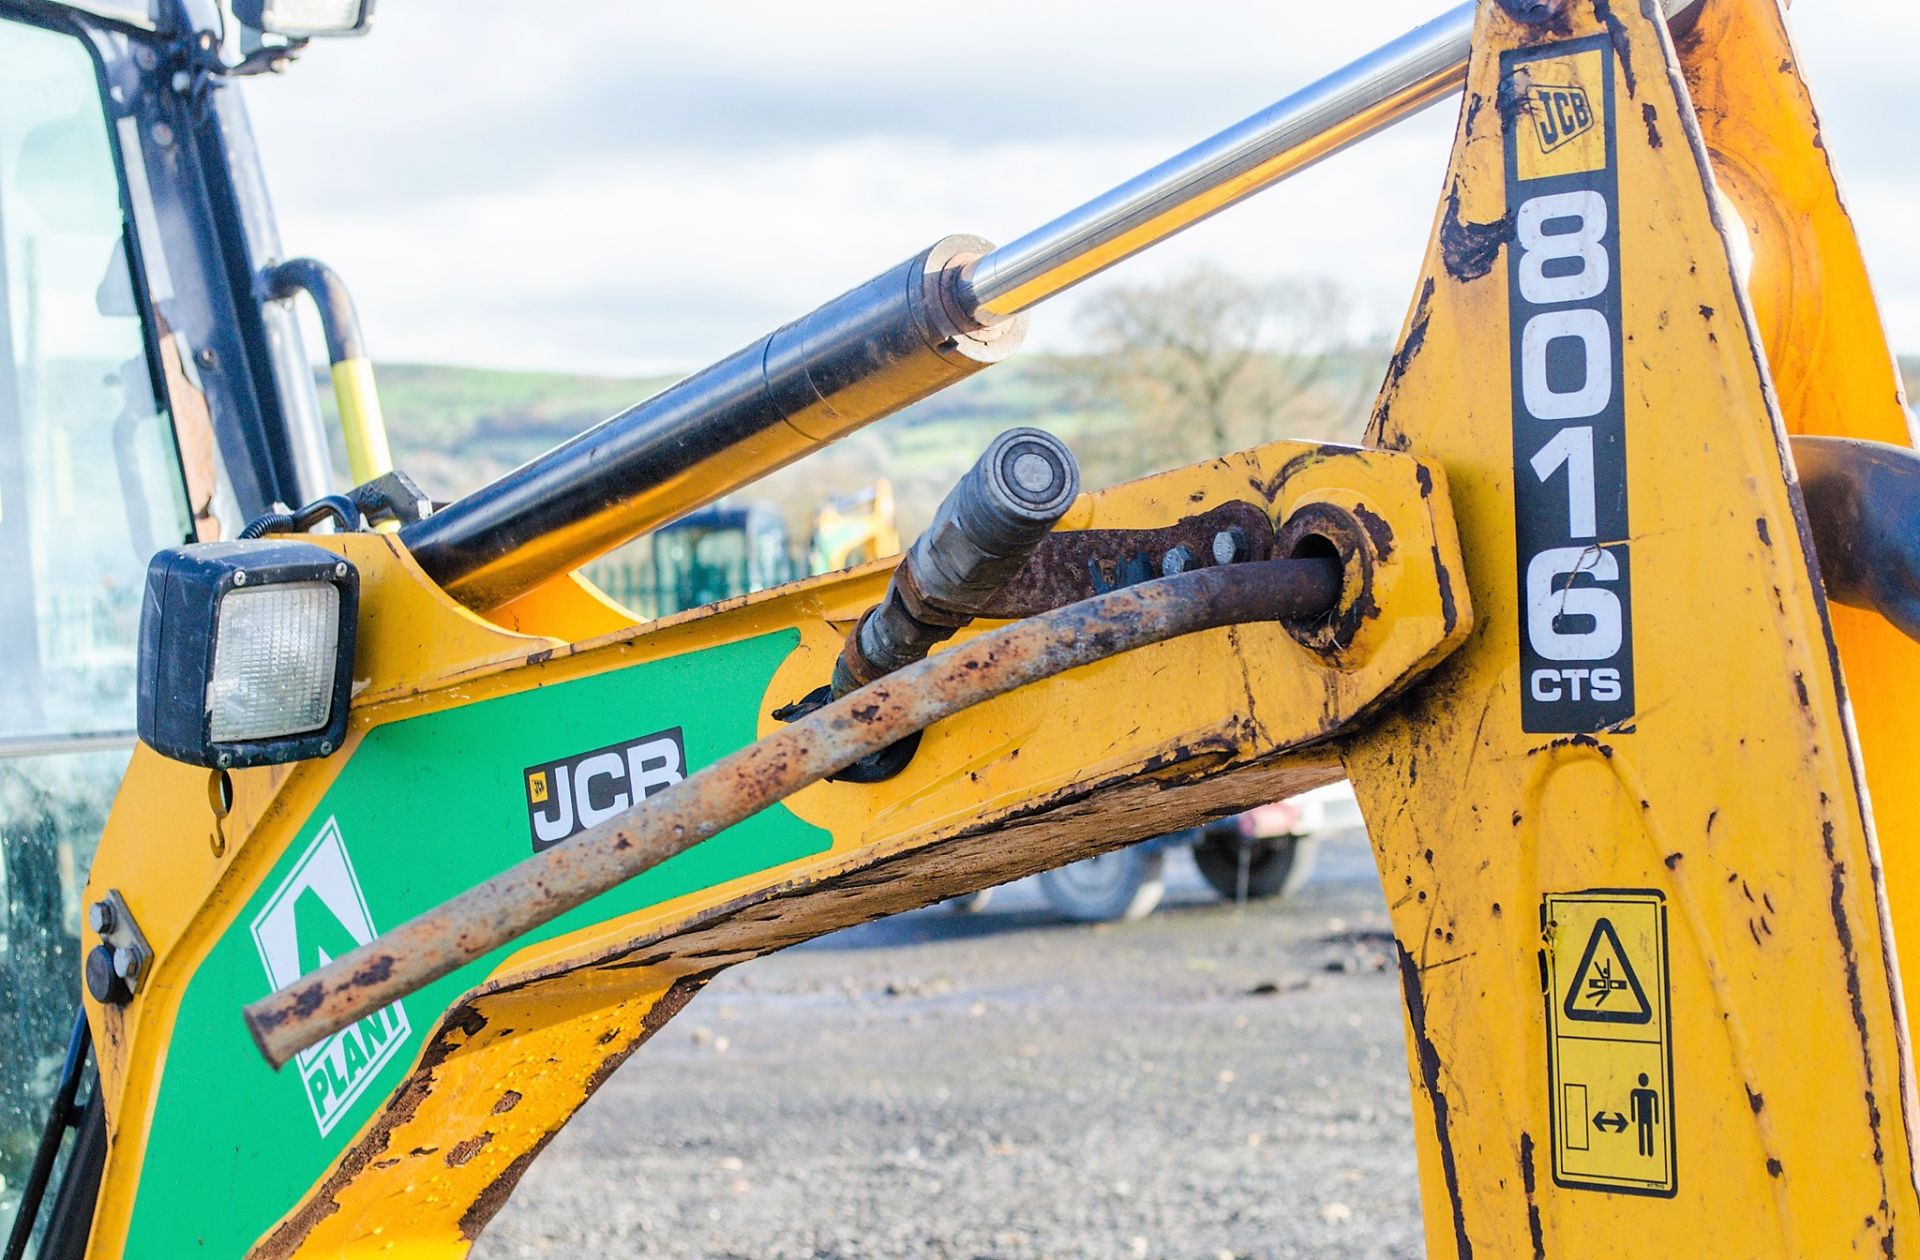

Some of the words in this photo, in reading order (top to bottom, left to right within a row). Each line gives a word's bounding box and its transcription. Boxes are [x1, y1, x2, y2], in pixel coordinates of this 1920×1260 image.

[1536, 90, 1591, 145] JCB
[1516, 189, 1623, 661] 8016
[1530, 667, 1622, 702] CTS
[533, 737, 686, 842] JCB
